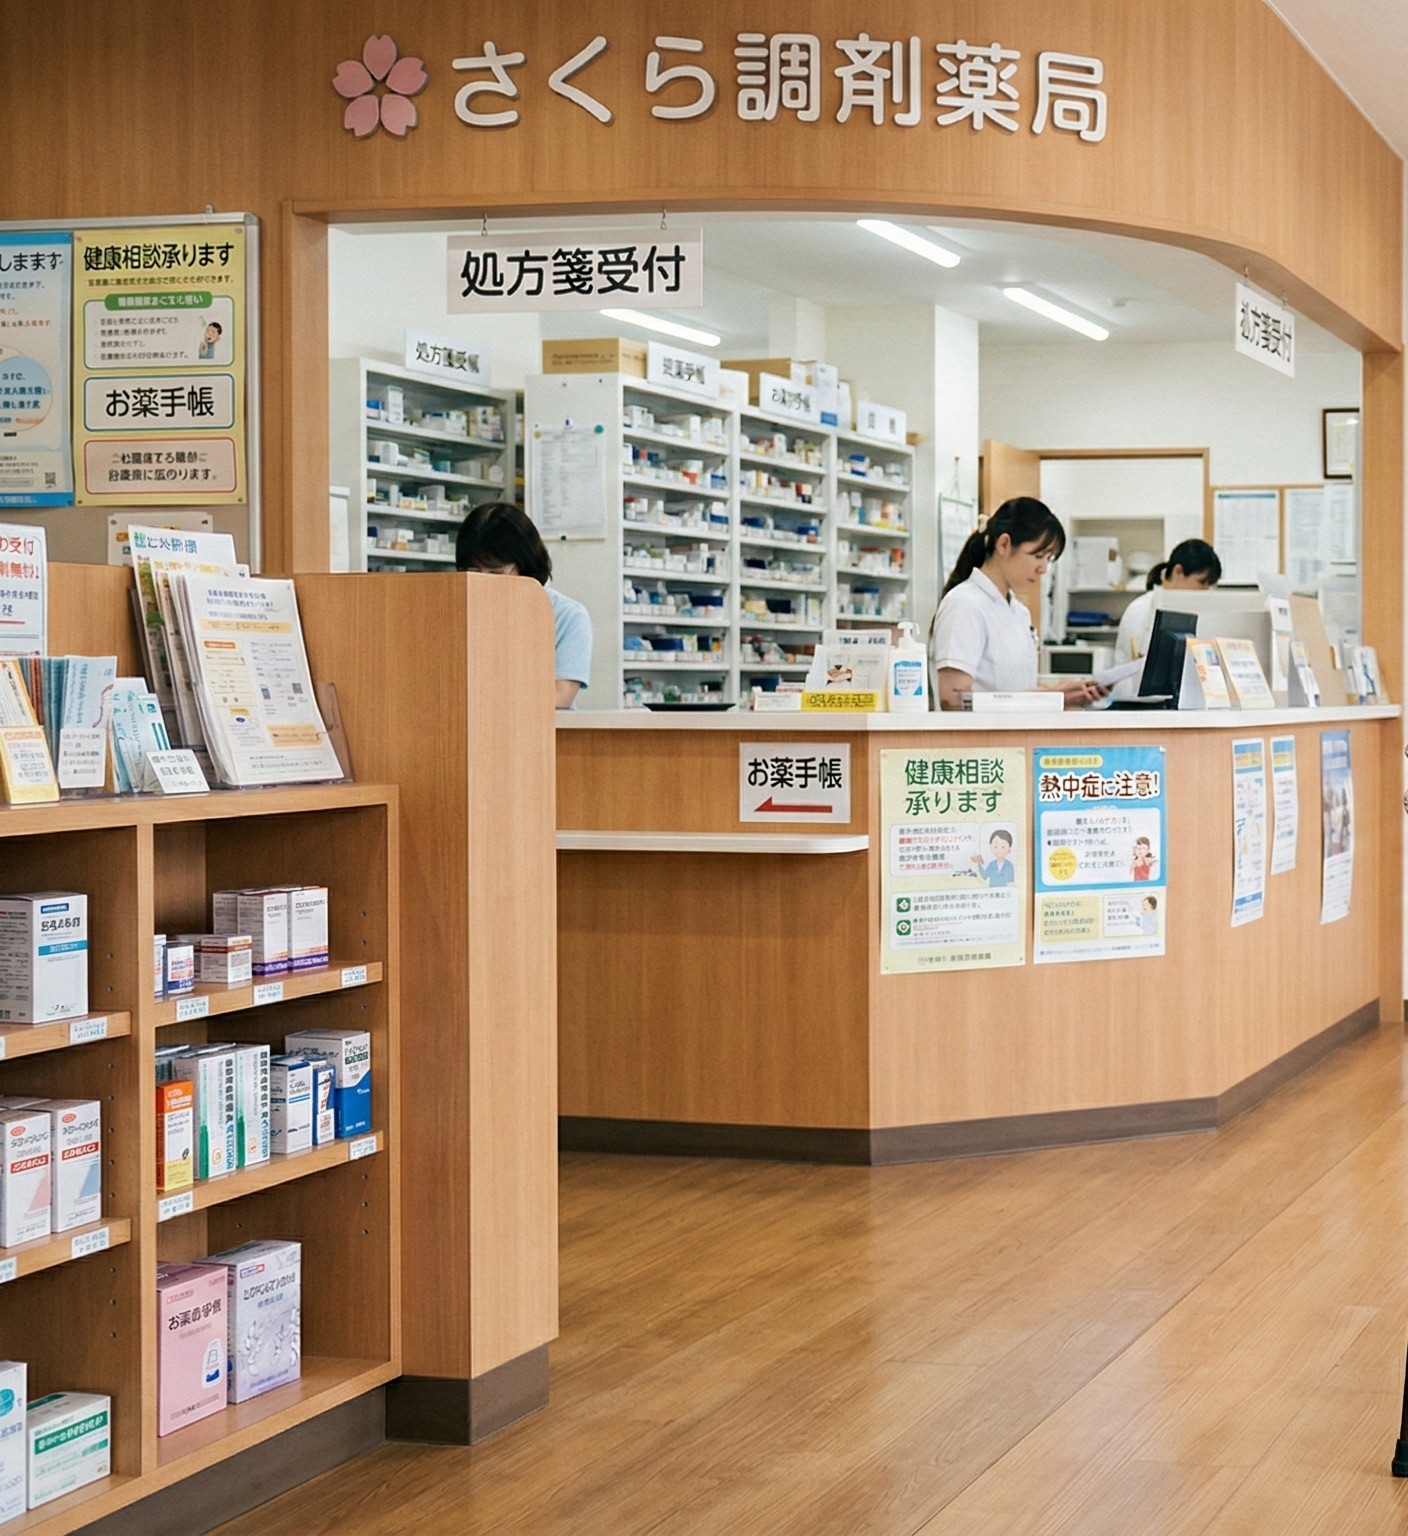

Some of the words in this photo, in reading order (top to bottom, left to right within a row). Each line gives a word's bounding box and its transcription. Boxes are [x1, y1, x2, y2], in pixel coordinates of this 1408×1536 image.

[452, 32, 1108, 143] さくら調剤薬局
[84, 242, 235, 271] 健康相談承ります
[460, 245, 686, 298] 処方箋受付
[105, 385, 215, 418] お薬手帳
[747, 756, 843, 790] お薬手帳
[905, 758, 1005, 786] 健康相談
[1040, 773, 1159, 799] 熱中症に注意!
[905, 789, 1003, 816] 承ります
